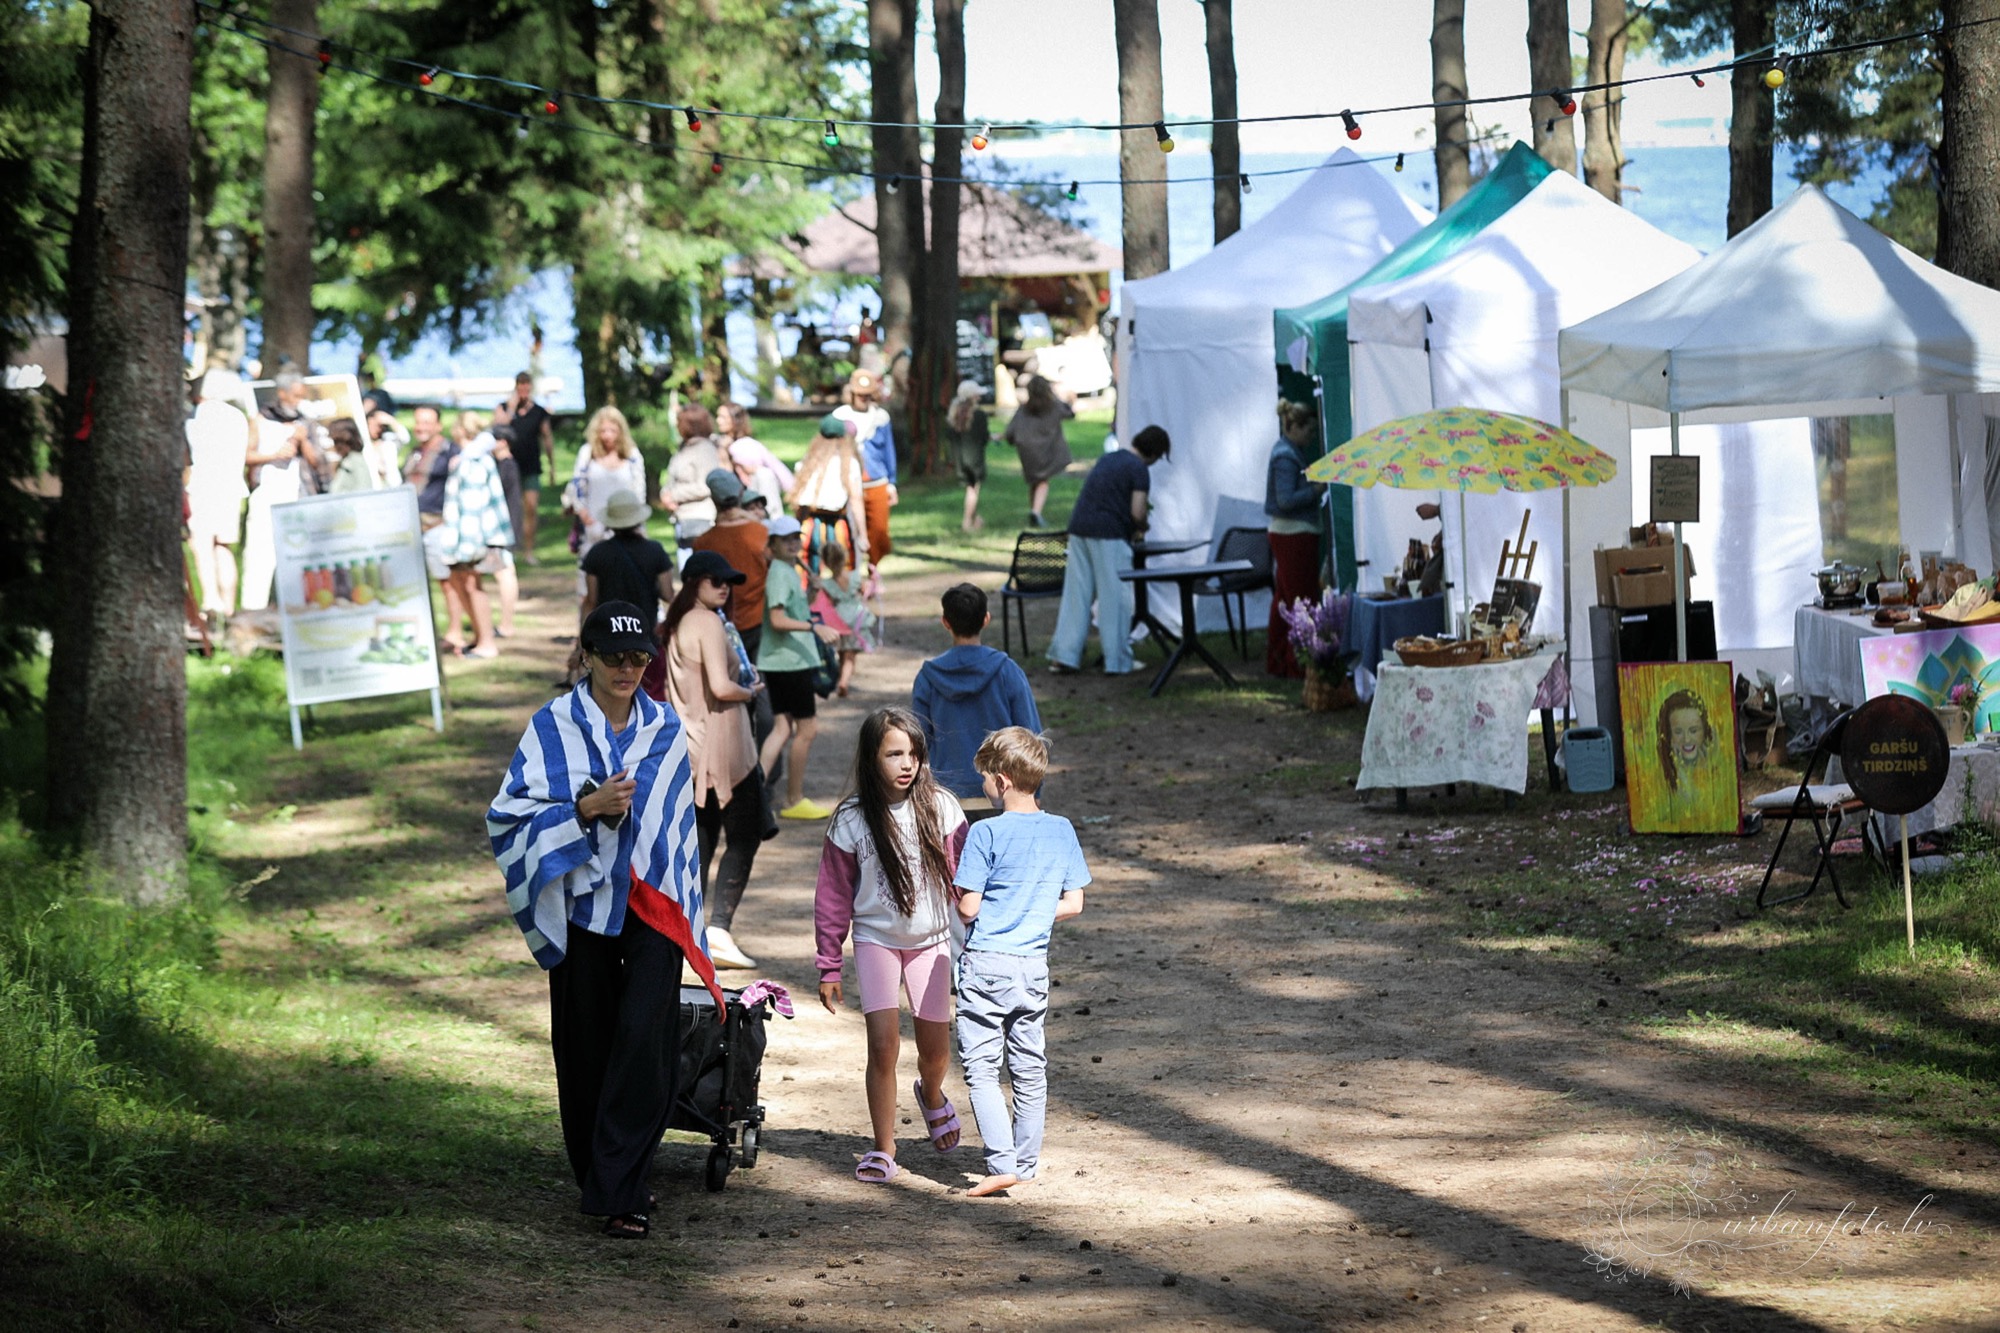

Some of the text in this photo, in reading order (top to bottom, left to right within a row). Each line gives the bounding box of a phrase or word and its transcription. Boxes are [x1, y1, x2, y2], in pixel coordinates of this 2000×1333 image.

[610, 616, 643, 633] NYC
[1869, 738, 1918, 754] GARŠU
[1862, 756, 1928, 776] TIRDZIŅŠ
